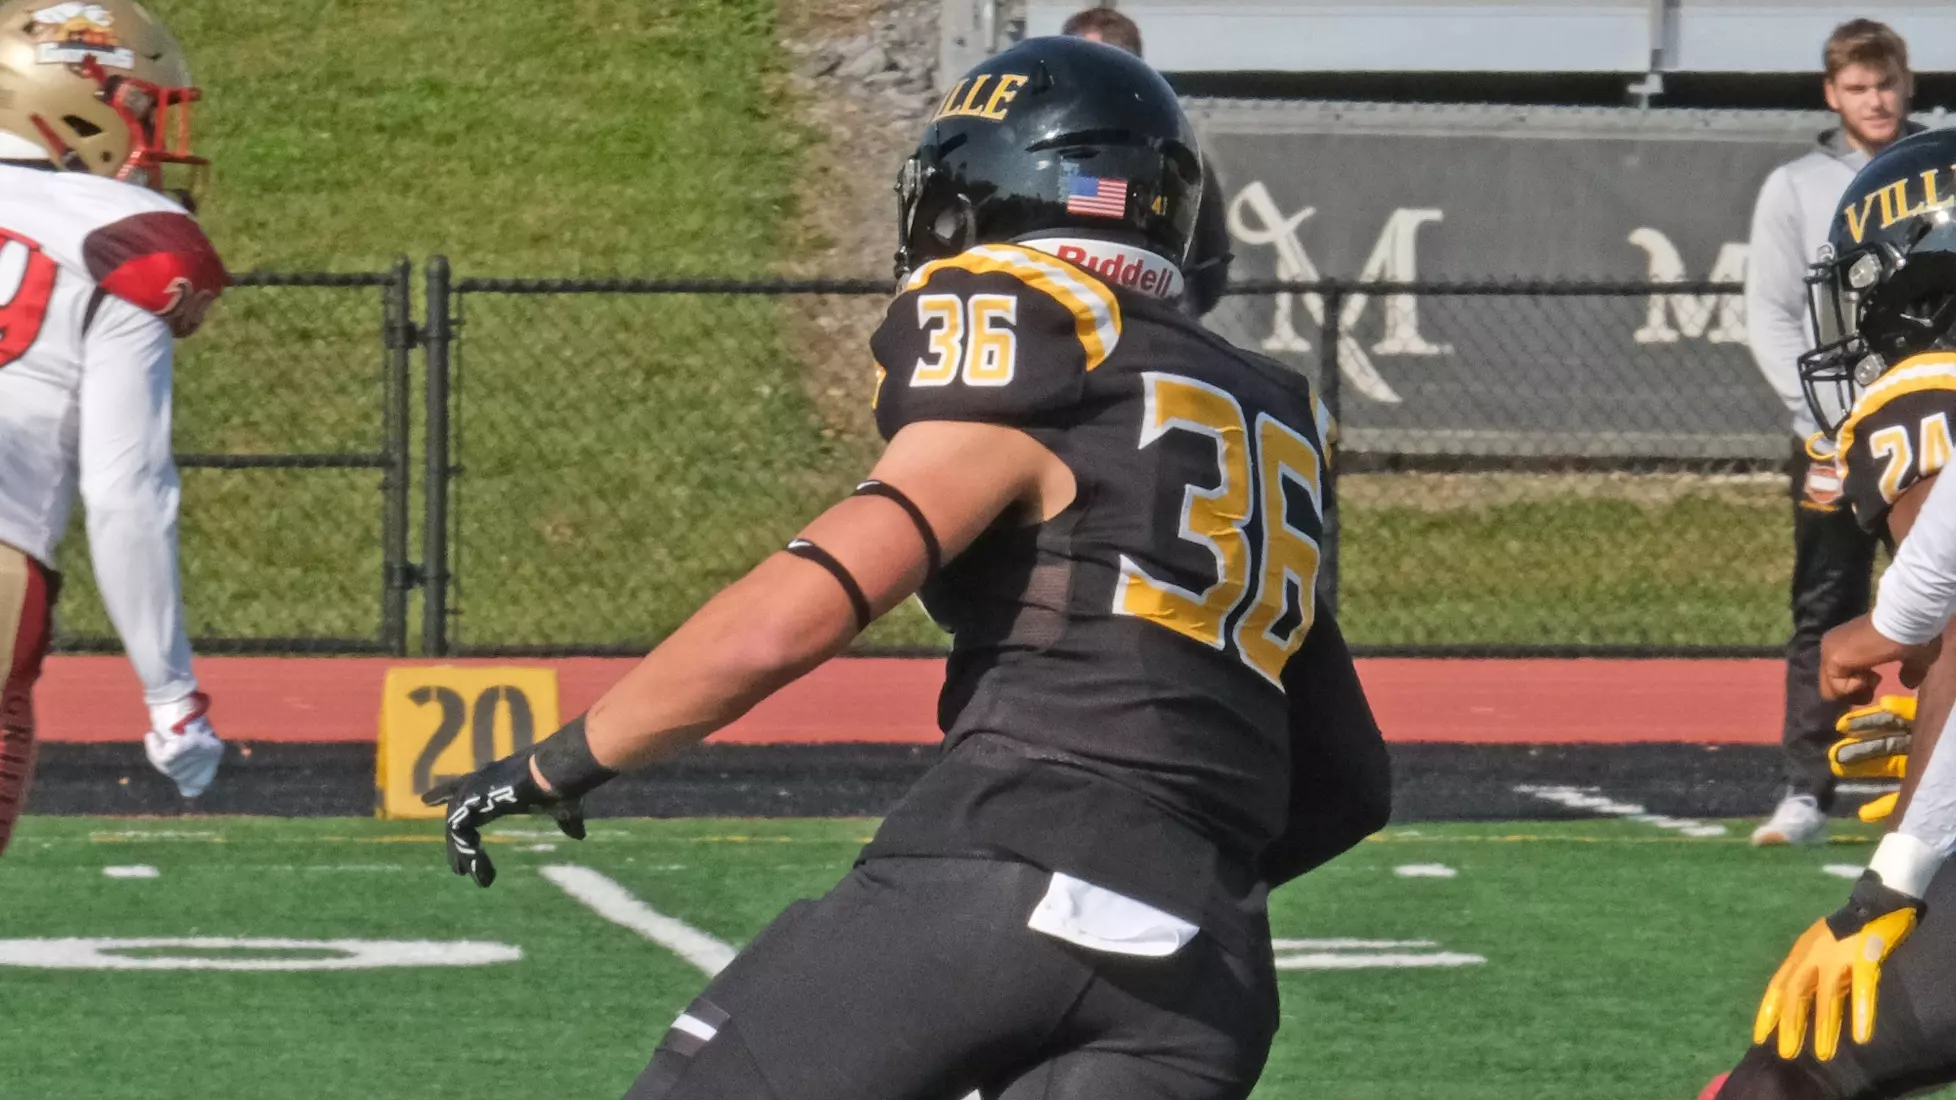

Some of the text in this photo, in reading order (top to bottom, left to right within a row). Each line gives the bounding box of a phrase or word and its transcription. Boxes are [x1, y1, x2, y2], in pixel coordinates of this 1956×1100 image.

[1843, 163, 1956, 244] VILL
[1056, 244, 1174, 299] Riddell
[909, 294, 1018, 388] 36
[1112, 371, 1324, 694] 36
[406, 684, 534, 797] 20
